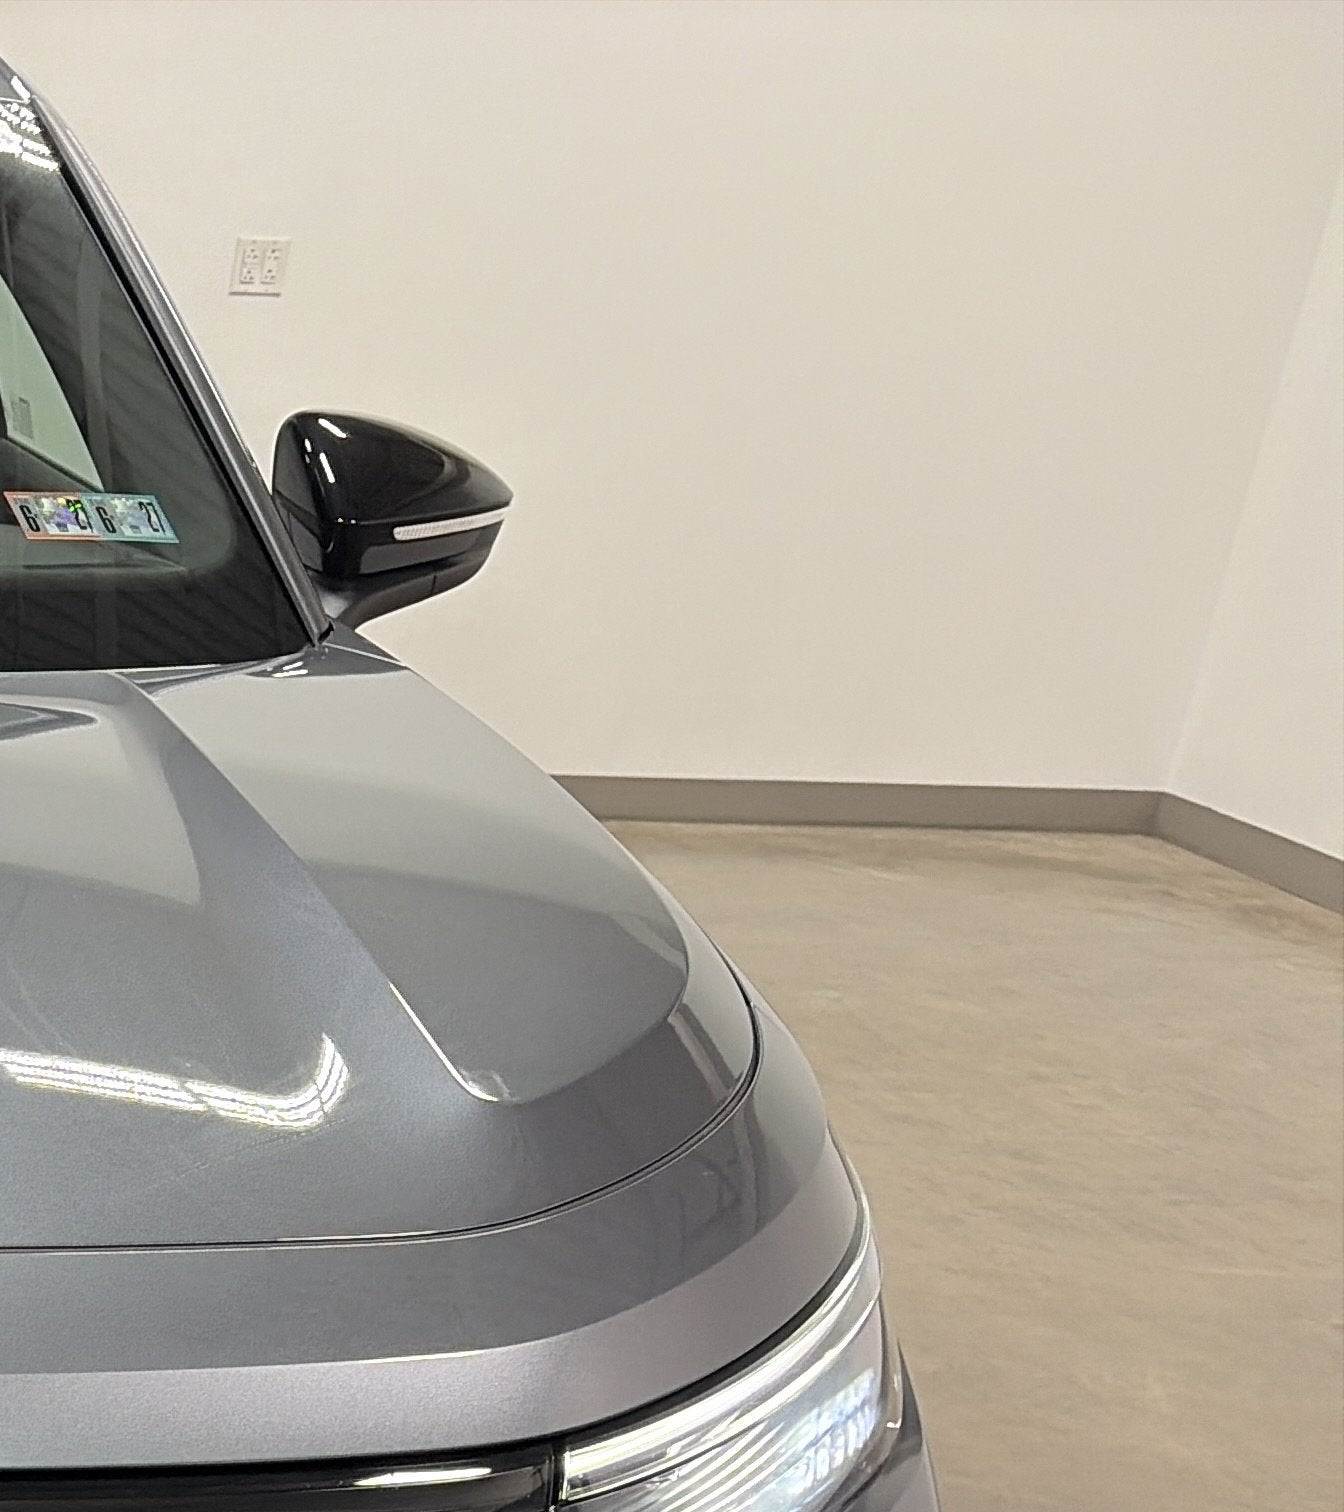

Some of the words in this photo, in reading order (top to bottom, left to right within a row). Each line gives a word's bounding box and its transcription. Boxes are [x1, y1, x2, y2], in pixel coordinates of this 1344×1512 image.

[18, 504, 40, 532] 6
[95, 506, 117, 533] 6
[138, 501, 166, 534] 27
